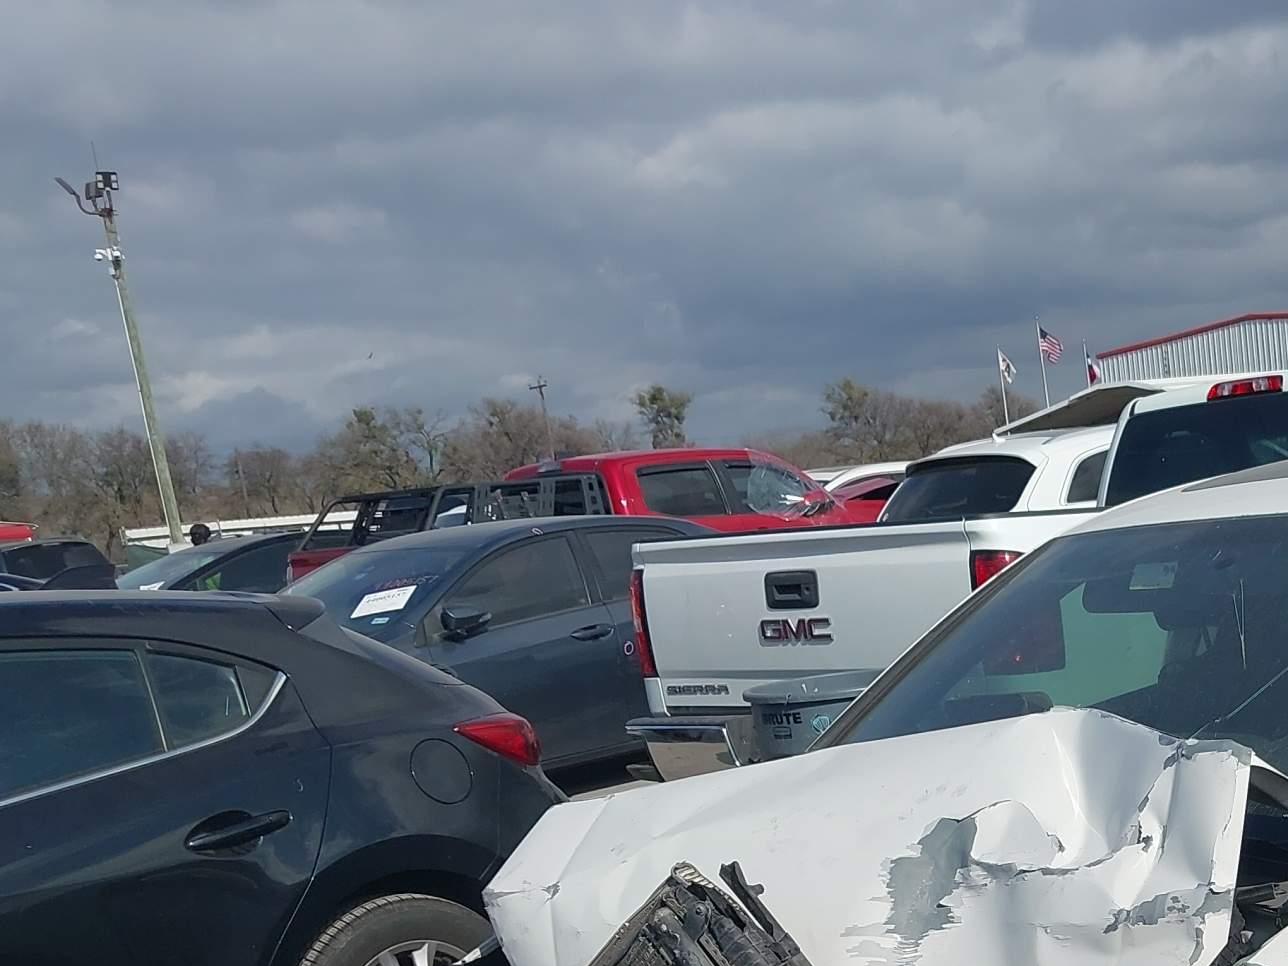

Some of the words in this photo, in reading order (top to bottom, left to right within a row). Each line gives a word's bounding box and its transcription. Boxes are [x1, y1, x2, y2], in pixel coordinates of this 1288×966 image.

[759, 617, 834, 643] GMC
[666, 684, 730, 696] SIERRA
[761, 711, 803, 726] BRUTE
